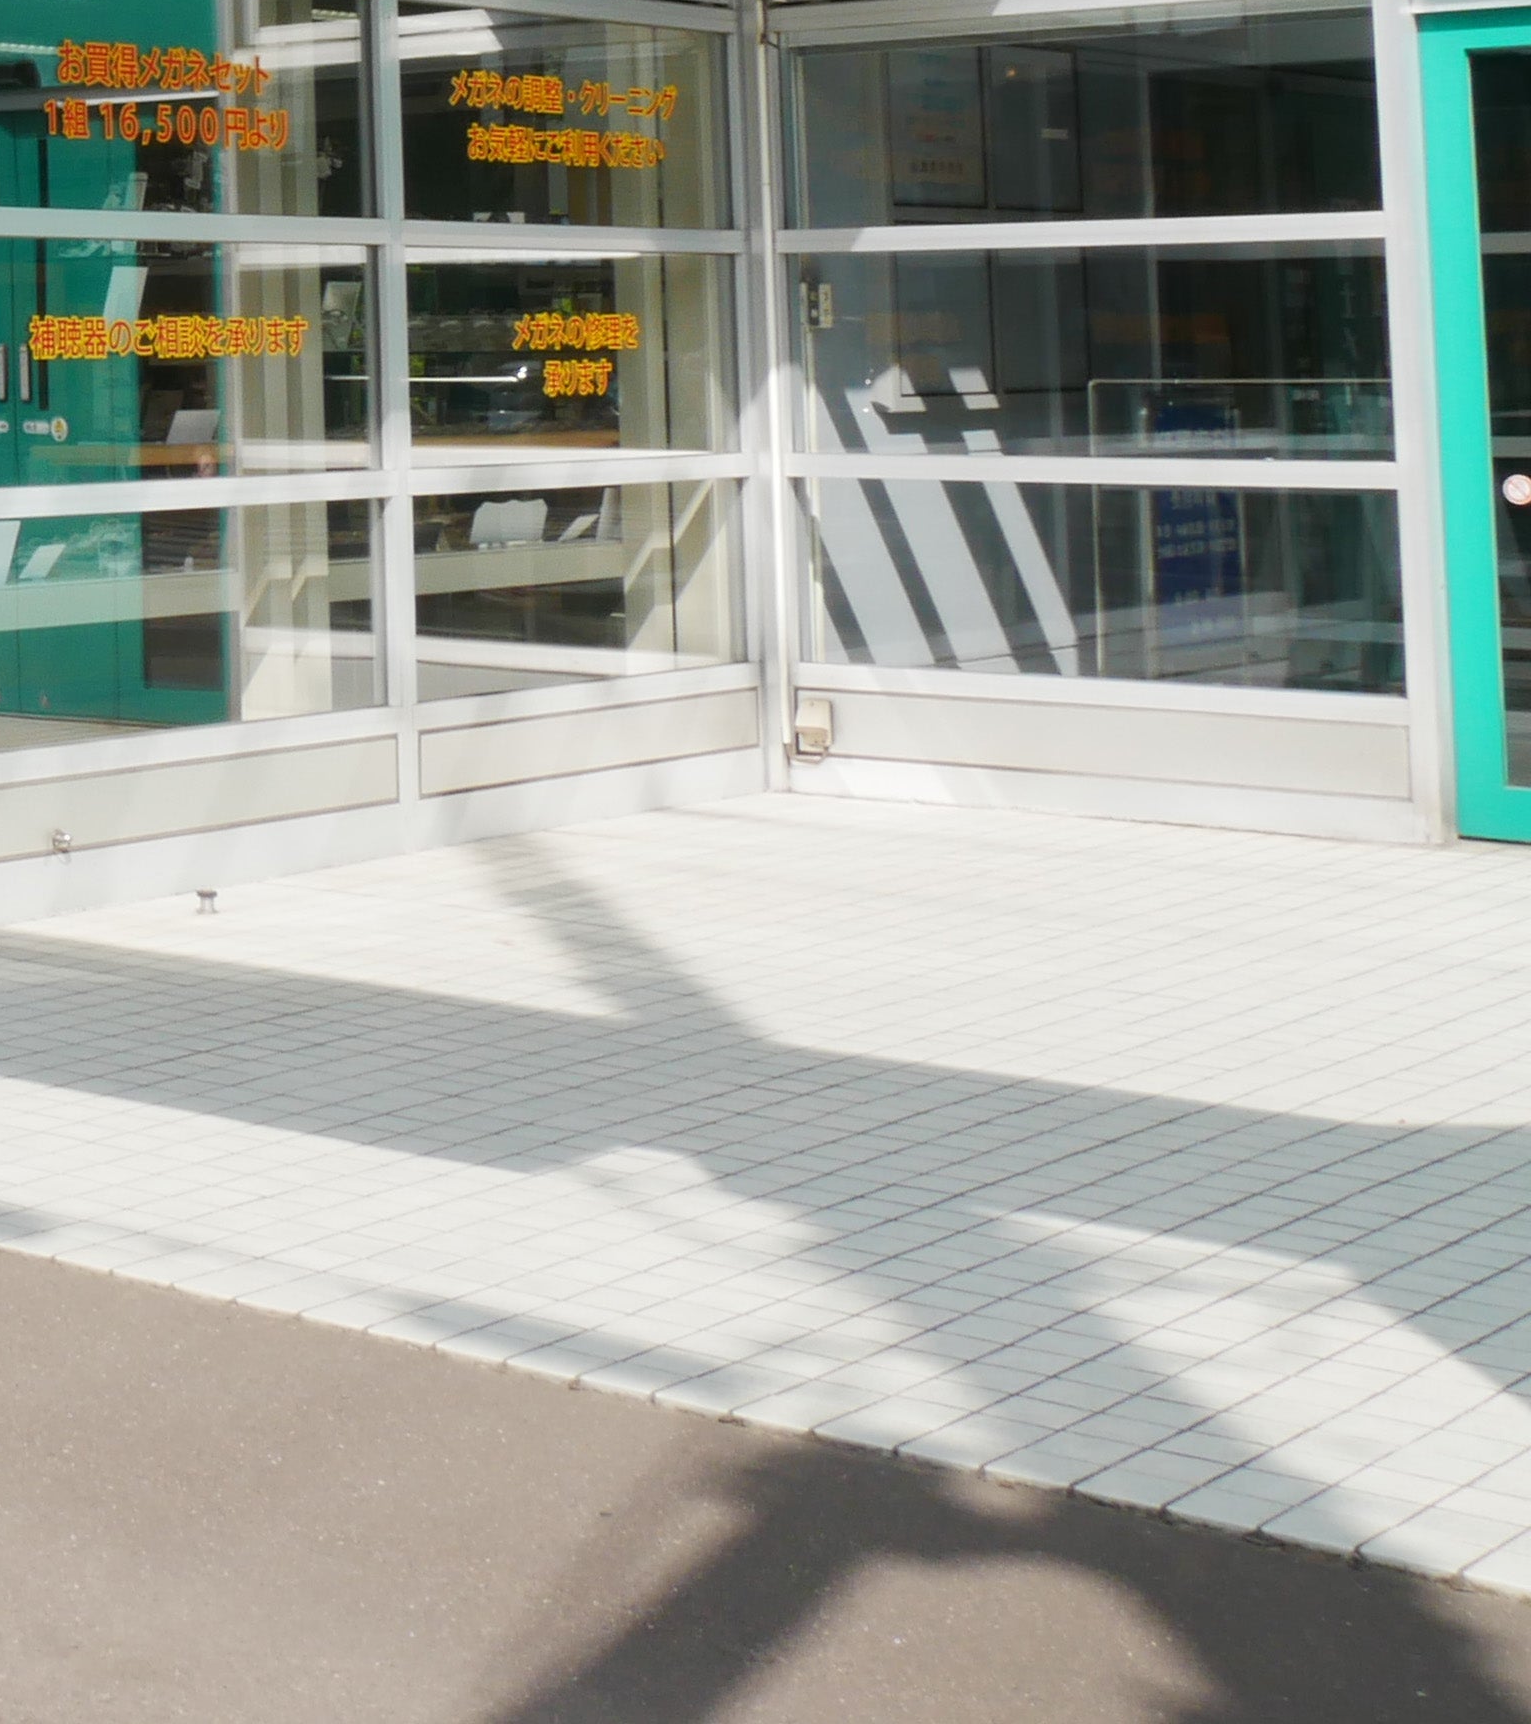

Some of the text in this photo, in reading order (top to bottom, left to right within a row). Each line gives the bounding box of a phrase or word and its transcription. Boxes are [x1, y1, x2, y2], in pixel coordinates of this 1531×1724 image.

[57, 39, 271, 96] お買得メガネセット
[448, 69, 679, 121] メガネの調整・クリーニング
[44, 98, 290, 151] 1組 16,500円より
[467, 122, 666, 169] お気軽にご利用ください
[28, 314, 310, 361] 補聴器のご相談を承ります
[511, 311, 640, 352] メガネの修理を
[542, 357, 614, 399] 承ります
